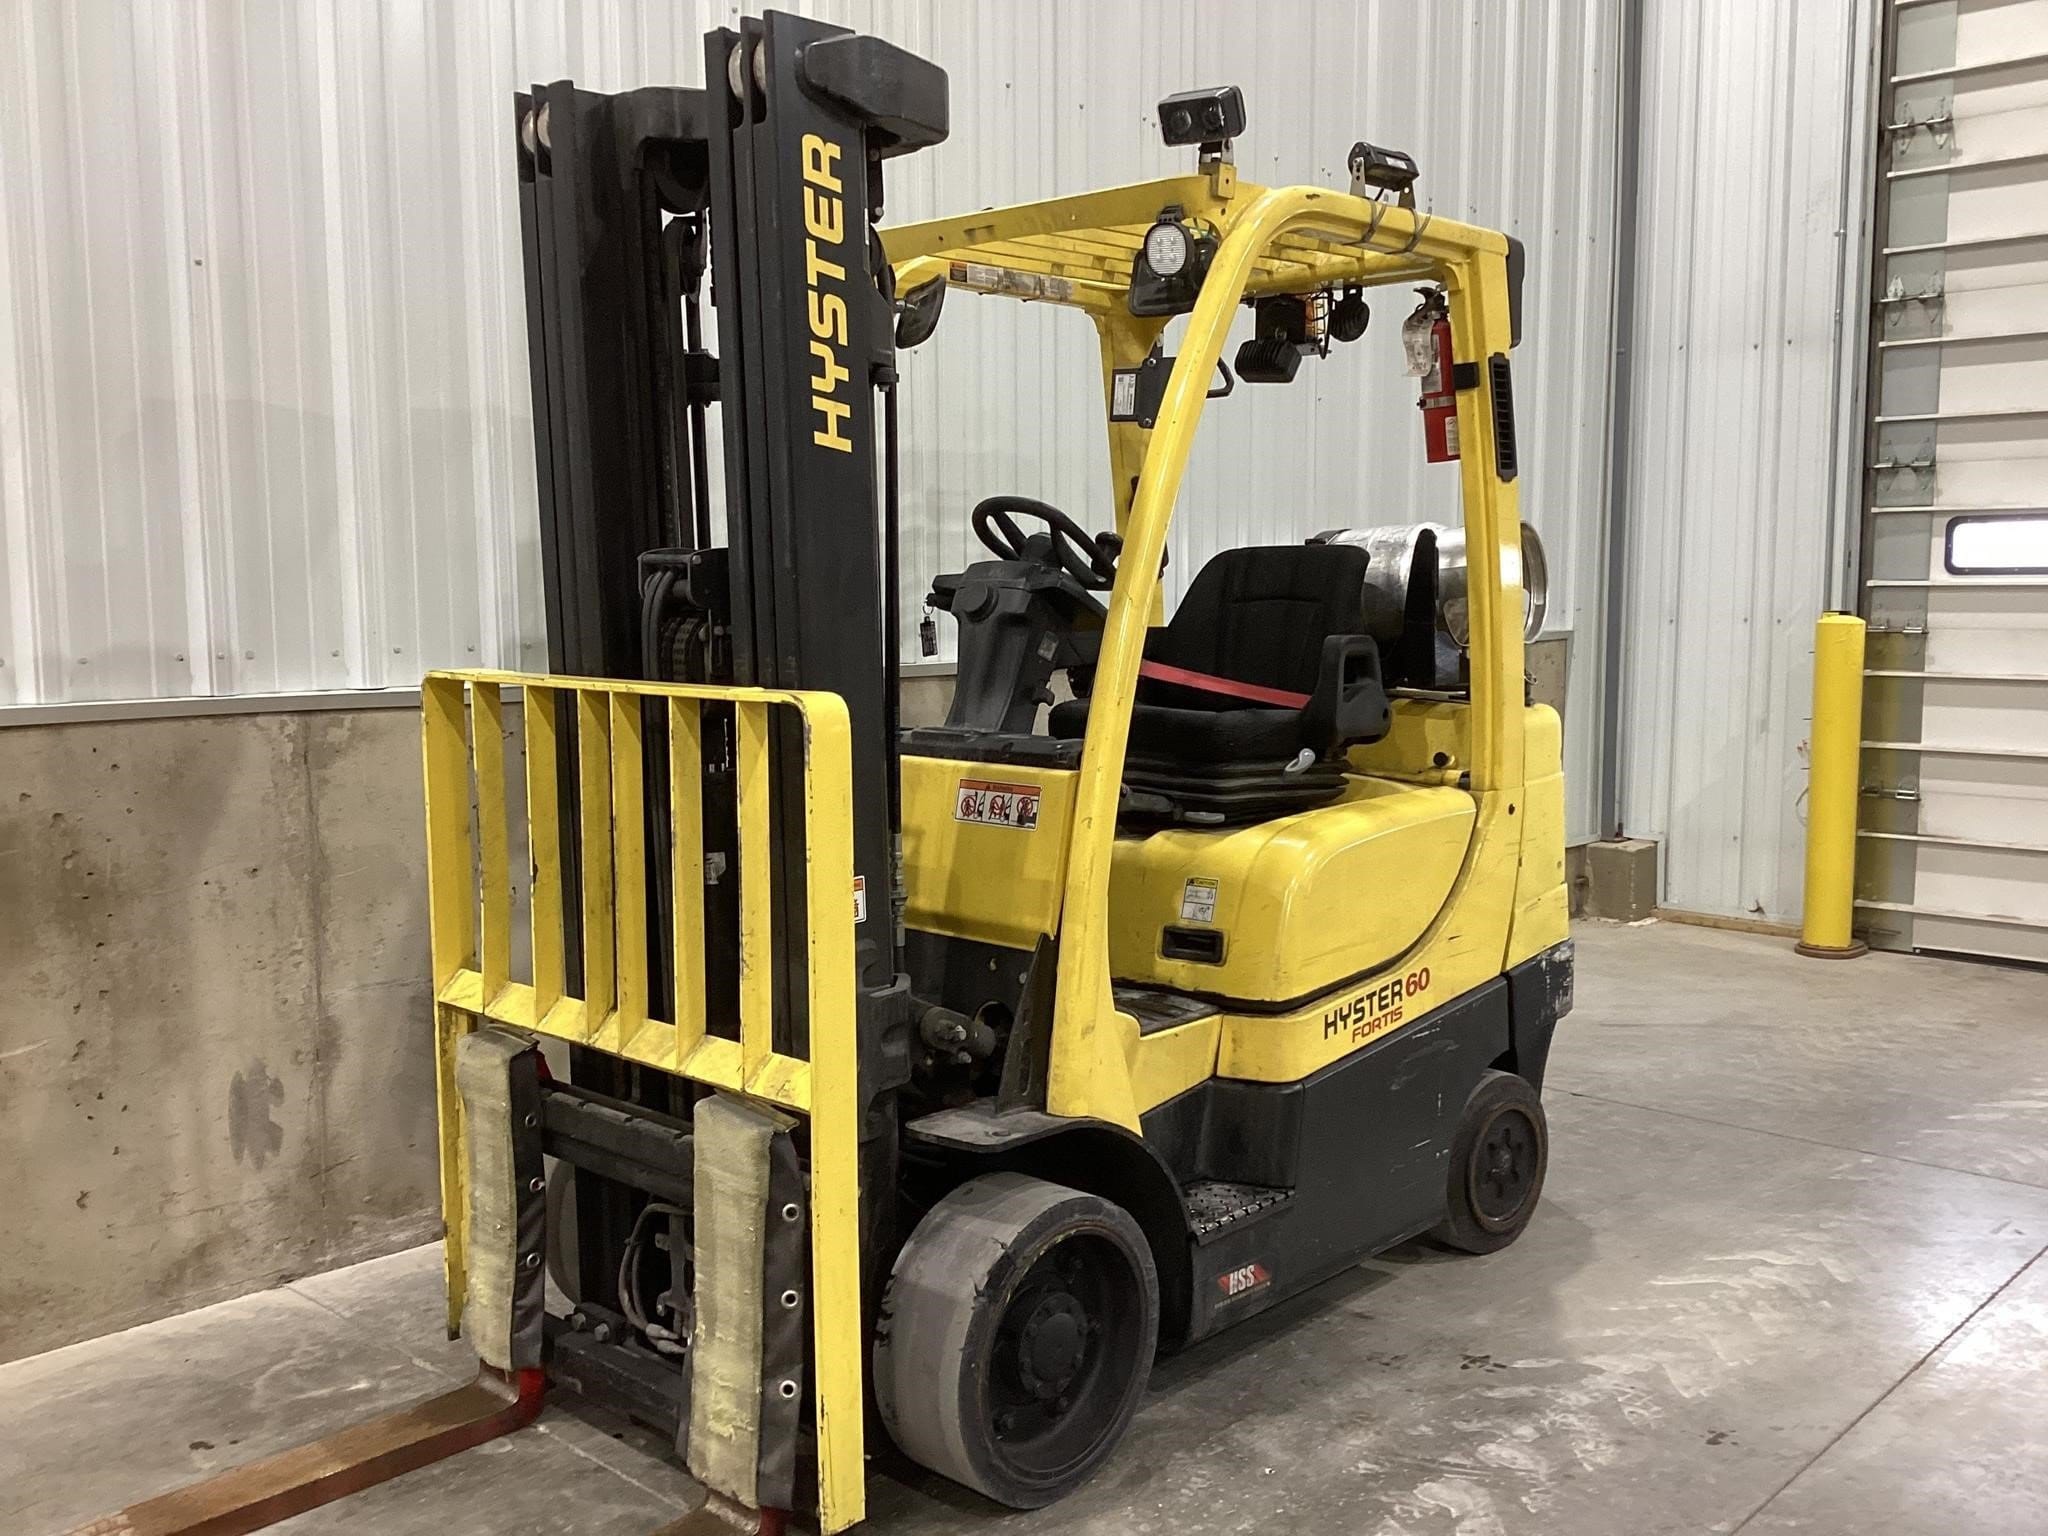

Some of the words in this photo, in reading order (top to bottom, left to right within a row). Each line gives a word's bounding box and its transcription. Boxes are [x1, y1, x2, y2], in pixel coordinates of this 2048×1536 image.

[802, 134, 852, 453] HYSTER
[1324, 978, 1403, 1040] HYSTER
[1405, 967, 1430, 997] 60
[1352, 1006, 1403, 1043] FORTIS
